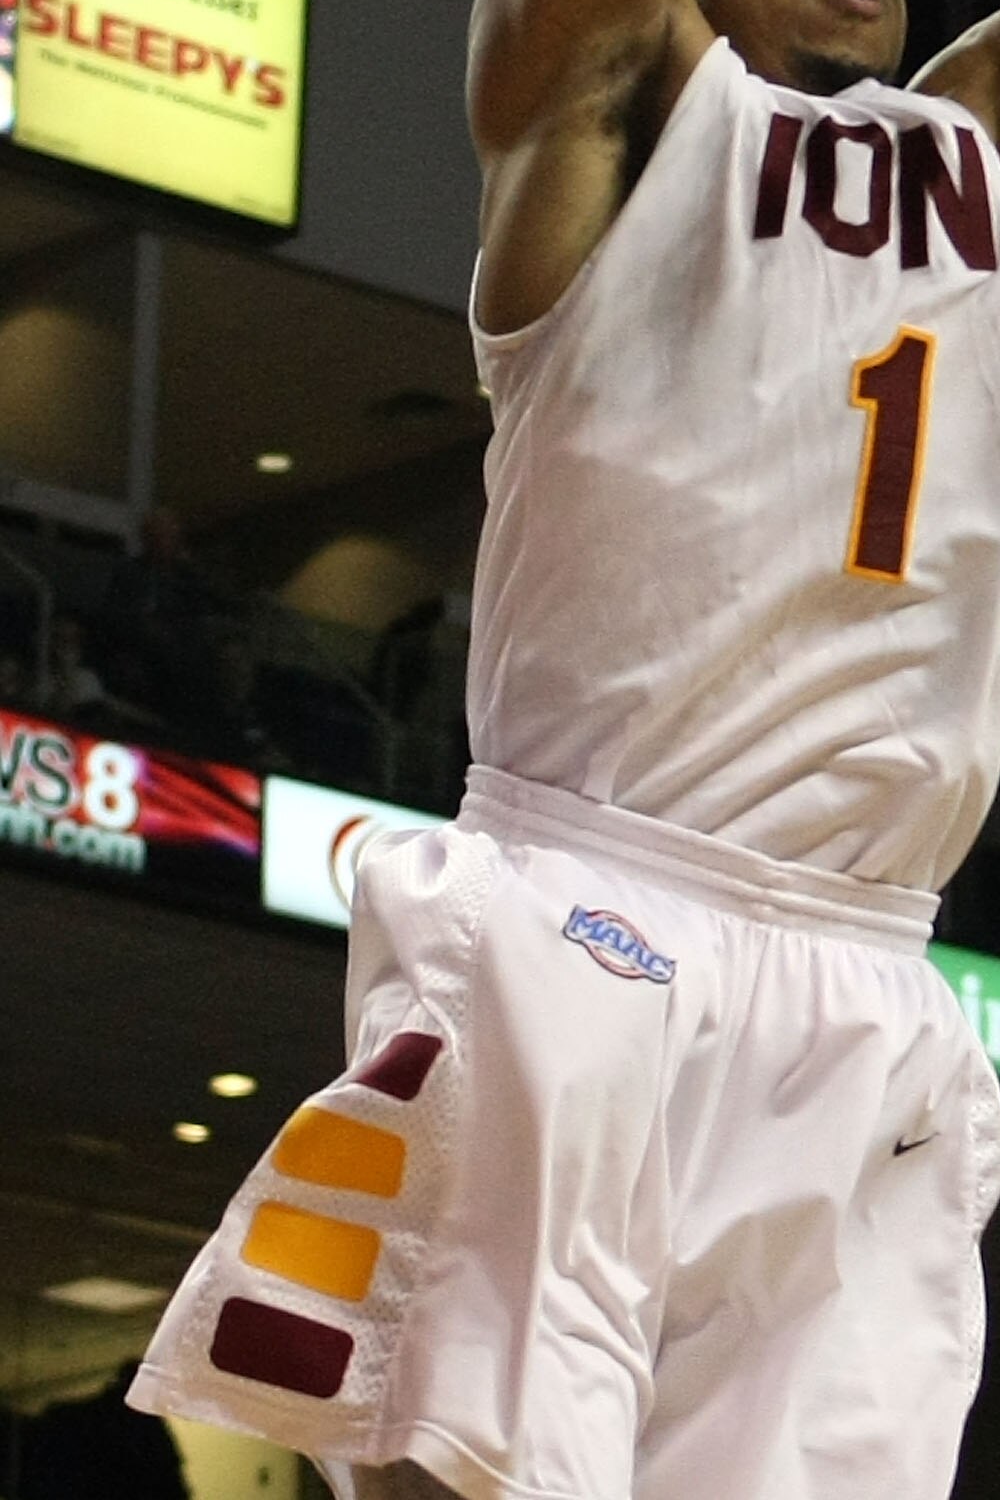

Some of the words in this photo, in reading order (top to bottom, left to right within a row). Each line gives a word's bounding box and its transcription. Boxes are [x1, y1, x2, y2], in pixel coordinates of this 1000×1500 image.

[844, 324, 938, 583] 1
[86, 741, 139, 832] 8
[564, 905, 675, 980] MAAC
